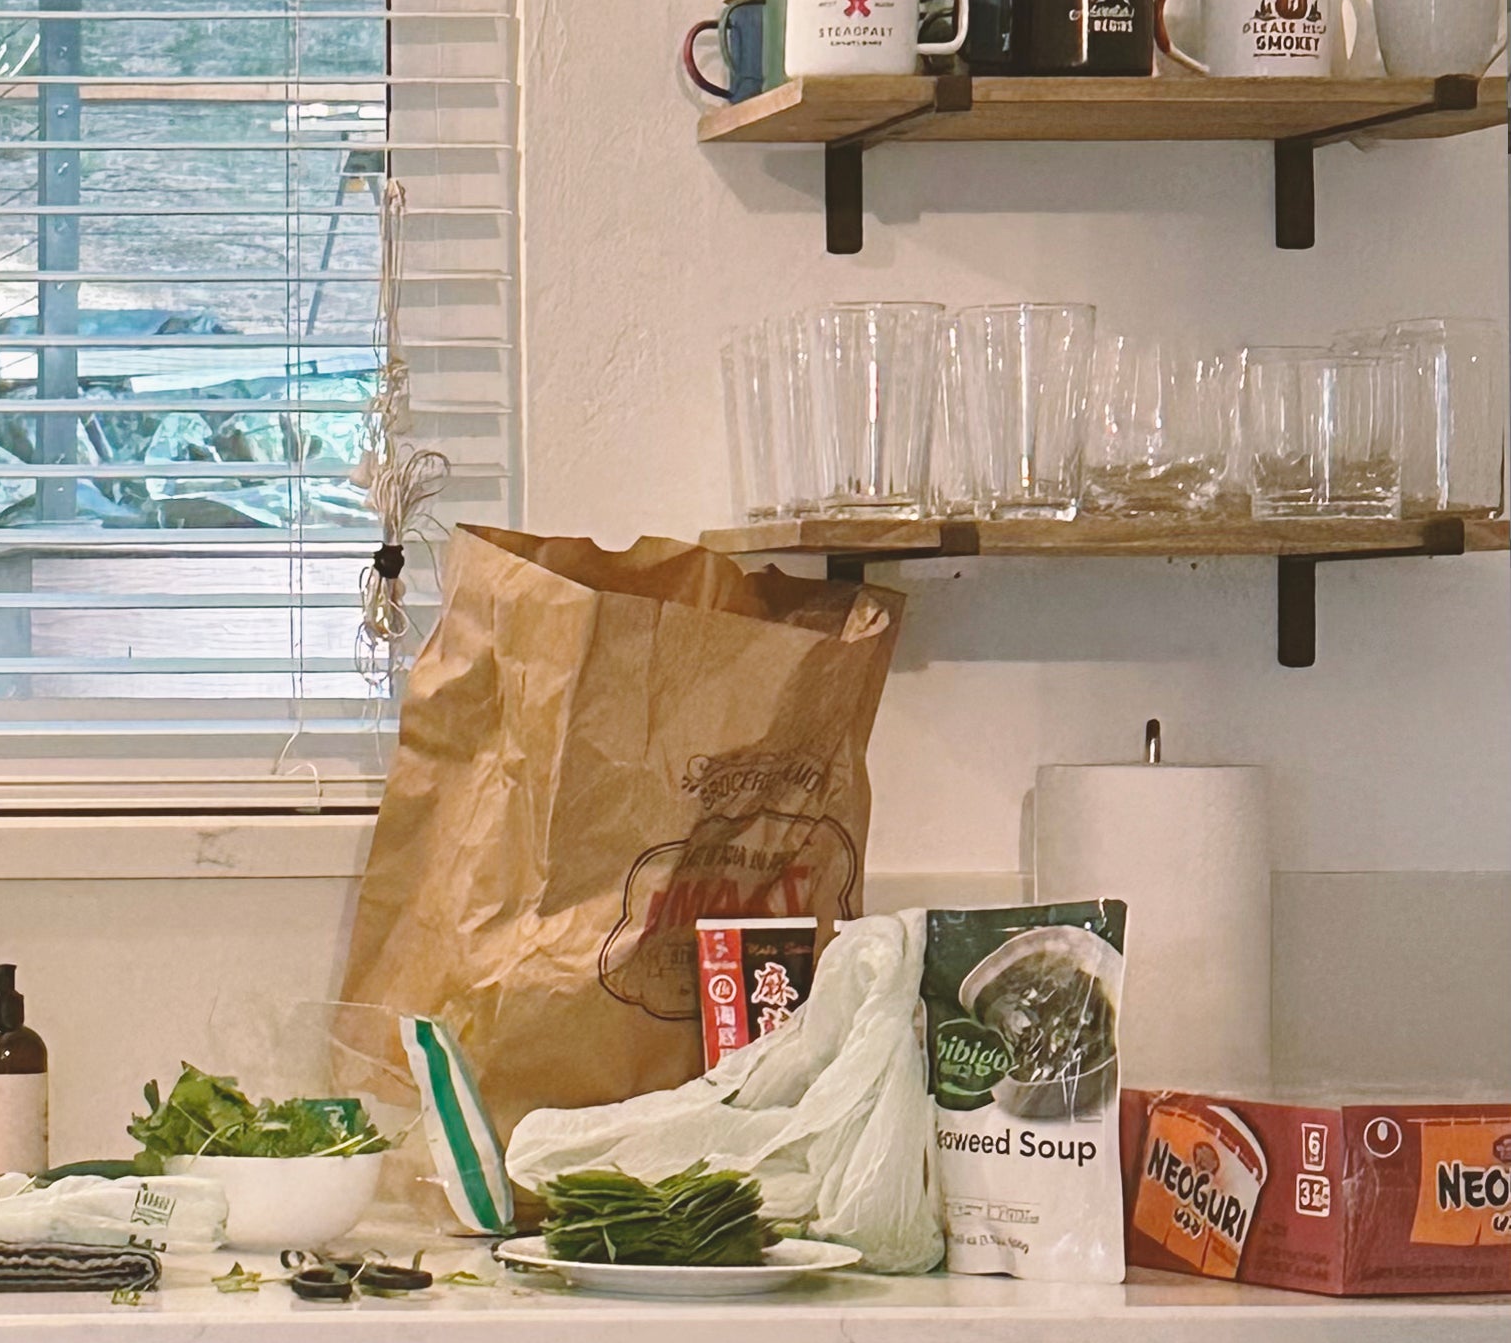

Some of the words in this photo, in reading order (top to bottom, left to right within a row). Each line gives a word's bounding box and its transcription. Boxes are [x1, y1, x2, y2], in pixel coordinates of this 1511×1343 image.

[1019, 1131, 1097, 1167] Soup
[1308, 1131, 1321, 1156] 6
[1147, 1137, 1247, 1243] NEOGURI
[1438, 1162, 1511, 1210] NEO
